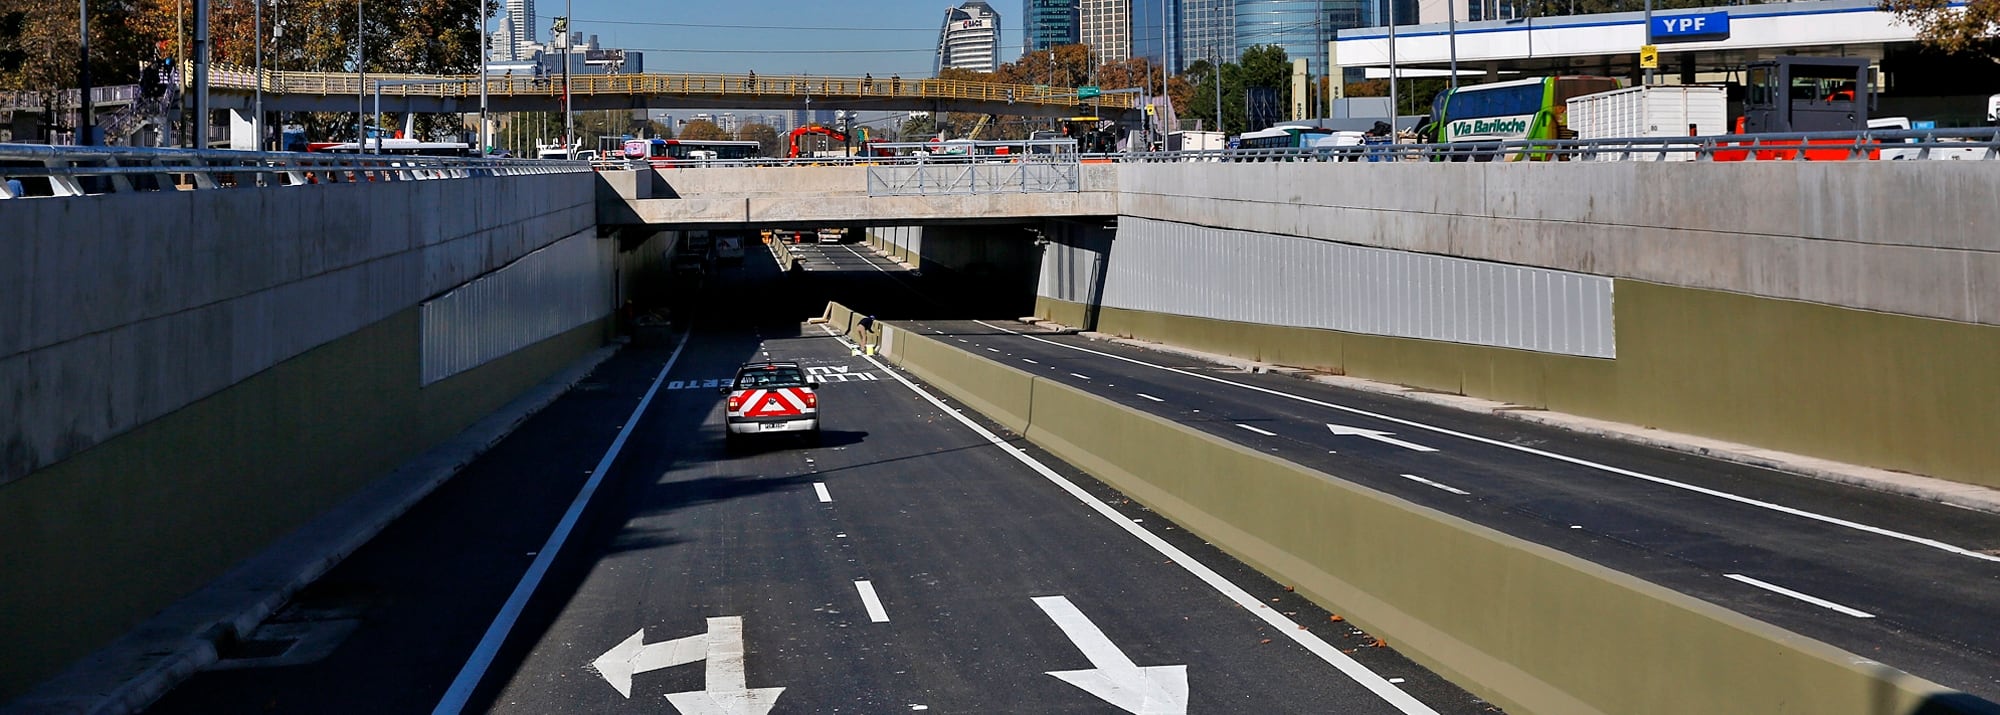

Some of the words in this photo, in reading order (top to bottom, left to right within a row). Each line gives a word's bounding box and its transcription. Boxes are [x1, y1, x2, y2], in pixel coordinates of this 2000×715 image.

[1663, 17, 1706, 33] YPF
[1453, 121, 1472, 137] Via
[1474, 118, 1526, 134] Bariloche
